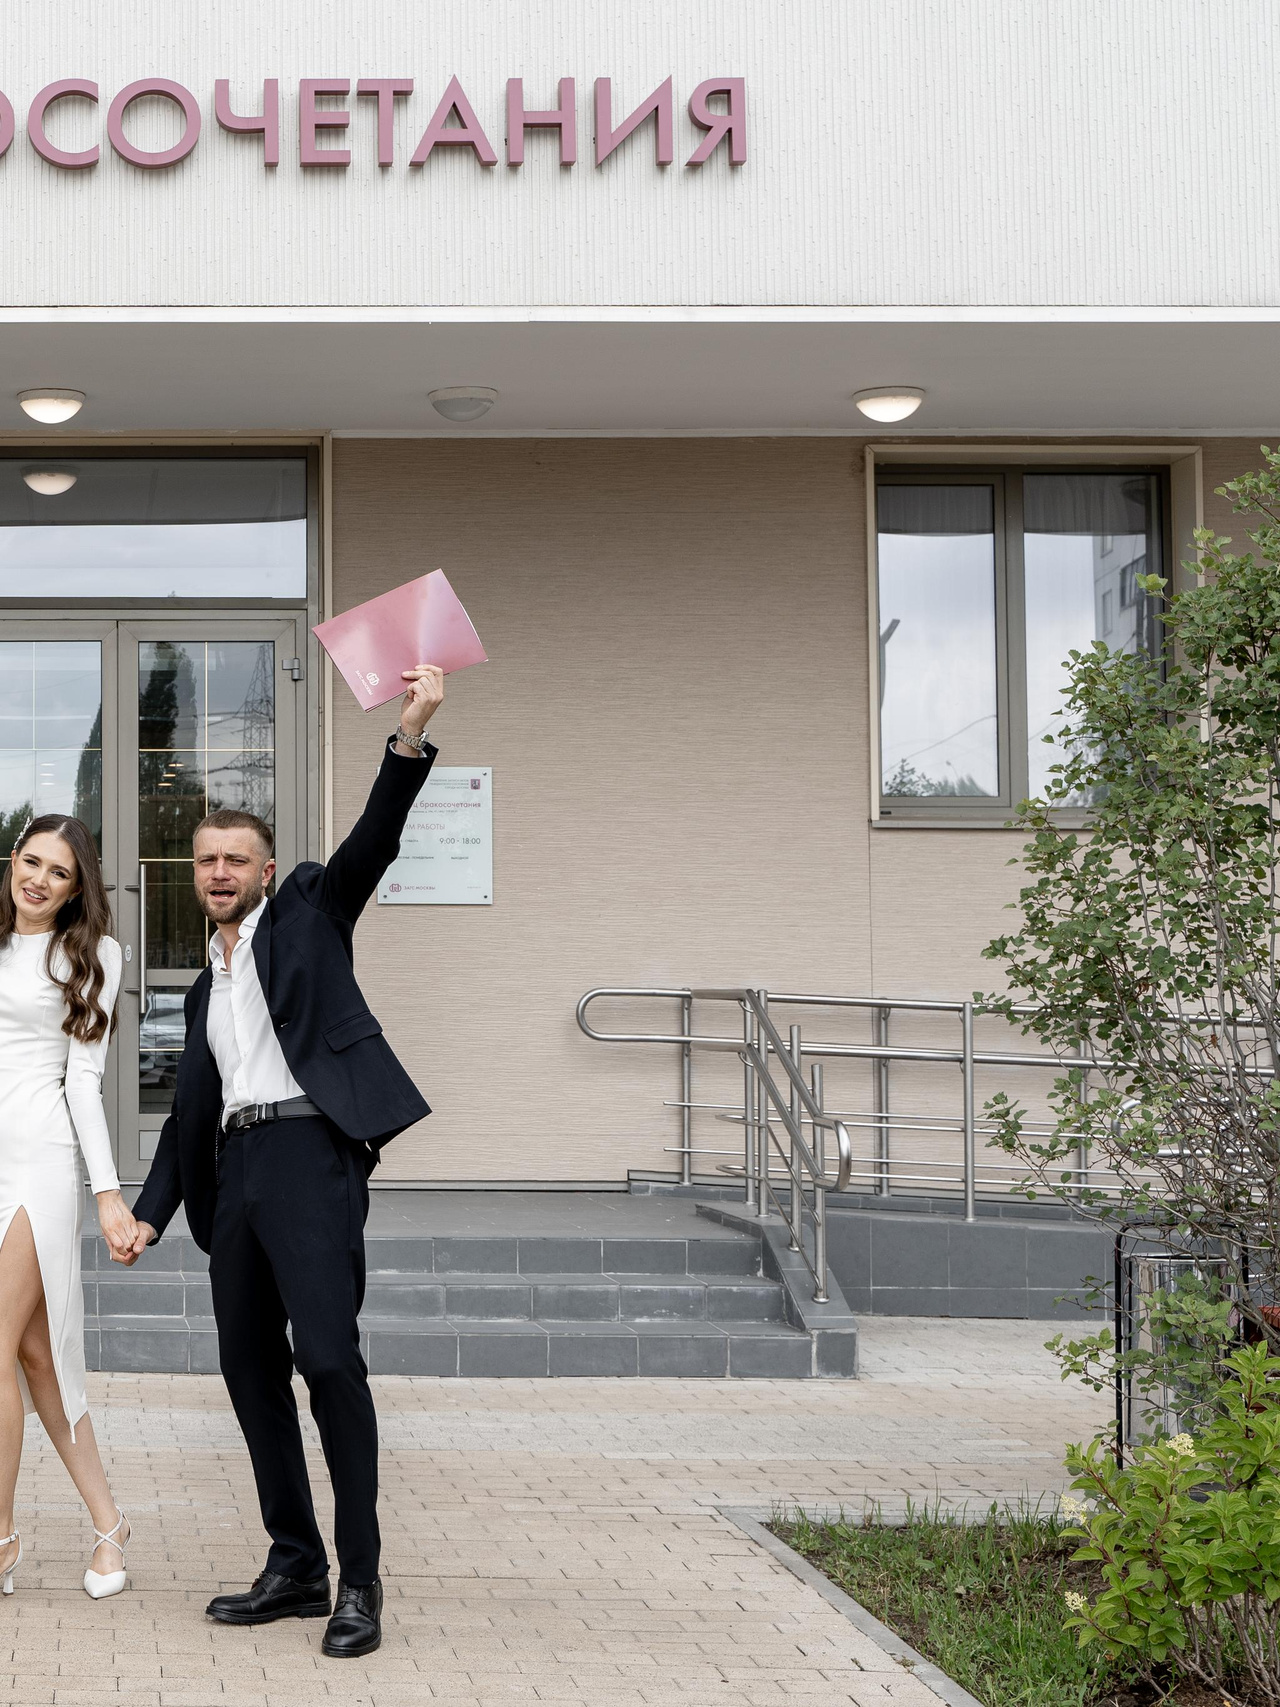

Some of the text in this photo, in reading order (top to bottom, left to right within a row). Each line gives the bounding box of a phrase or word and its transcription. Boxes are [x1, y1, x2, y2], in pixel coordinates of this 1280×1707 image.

[419, 800, 481, 809] бракосочетания
[439, 837, 456, 845] 9:00
[462, 837, 481, 845] 18:00
